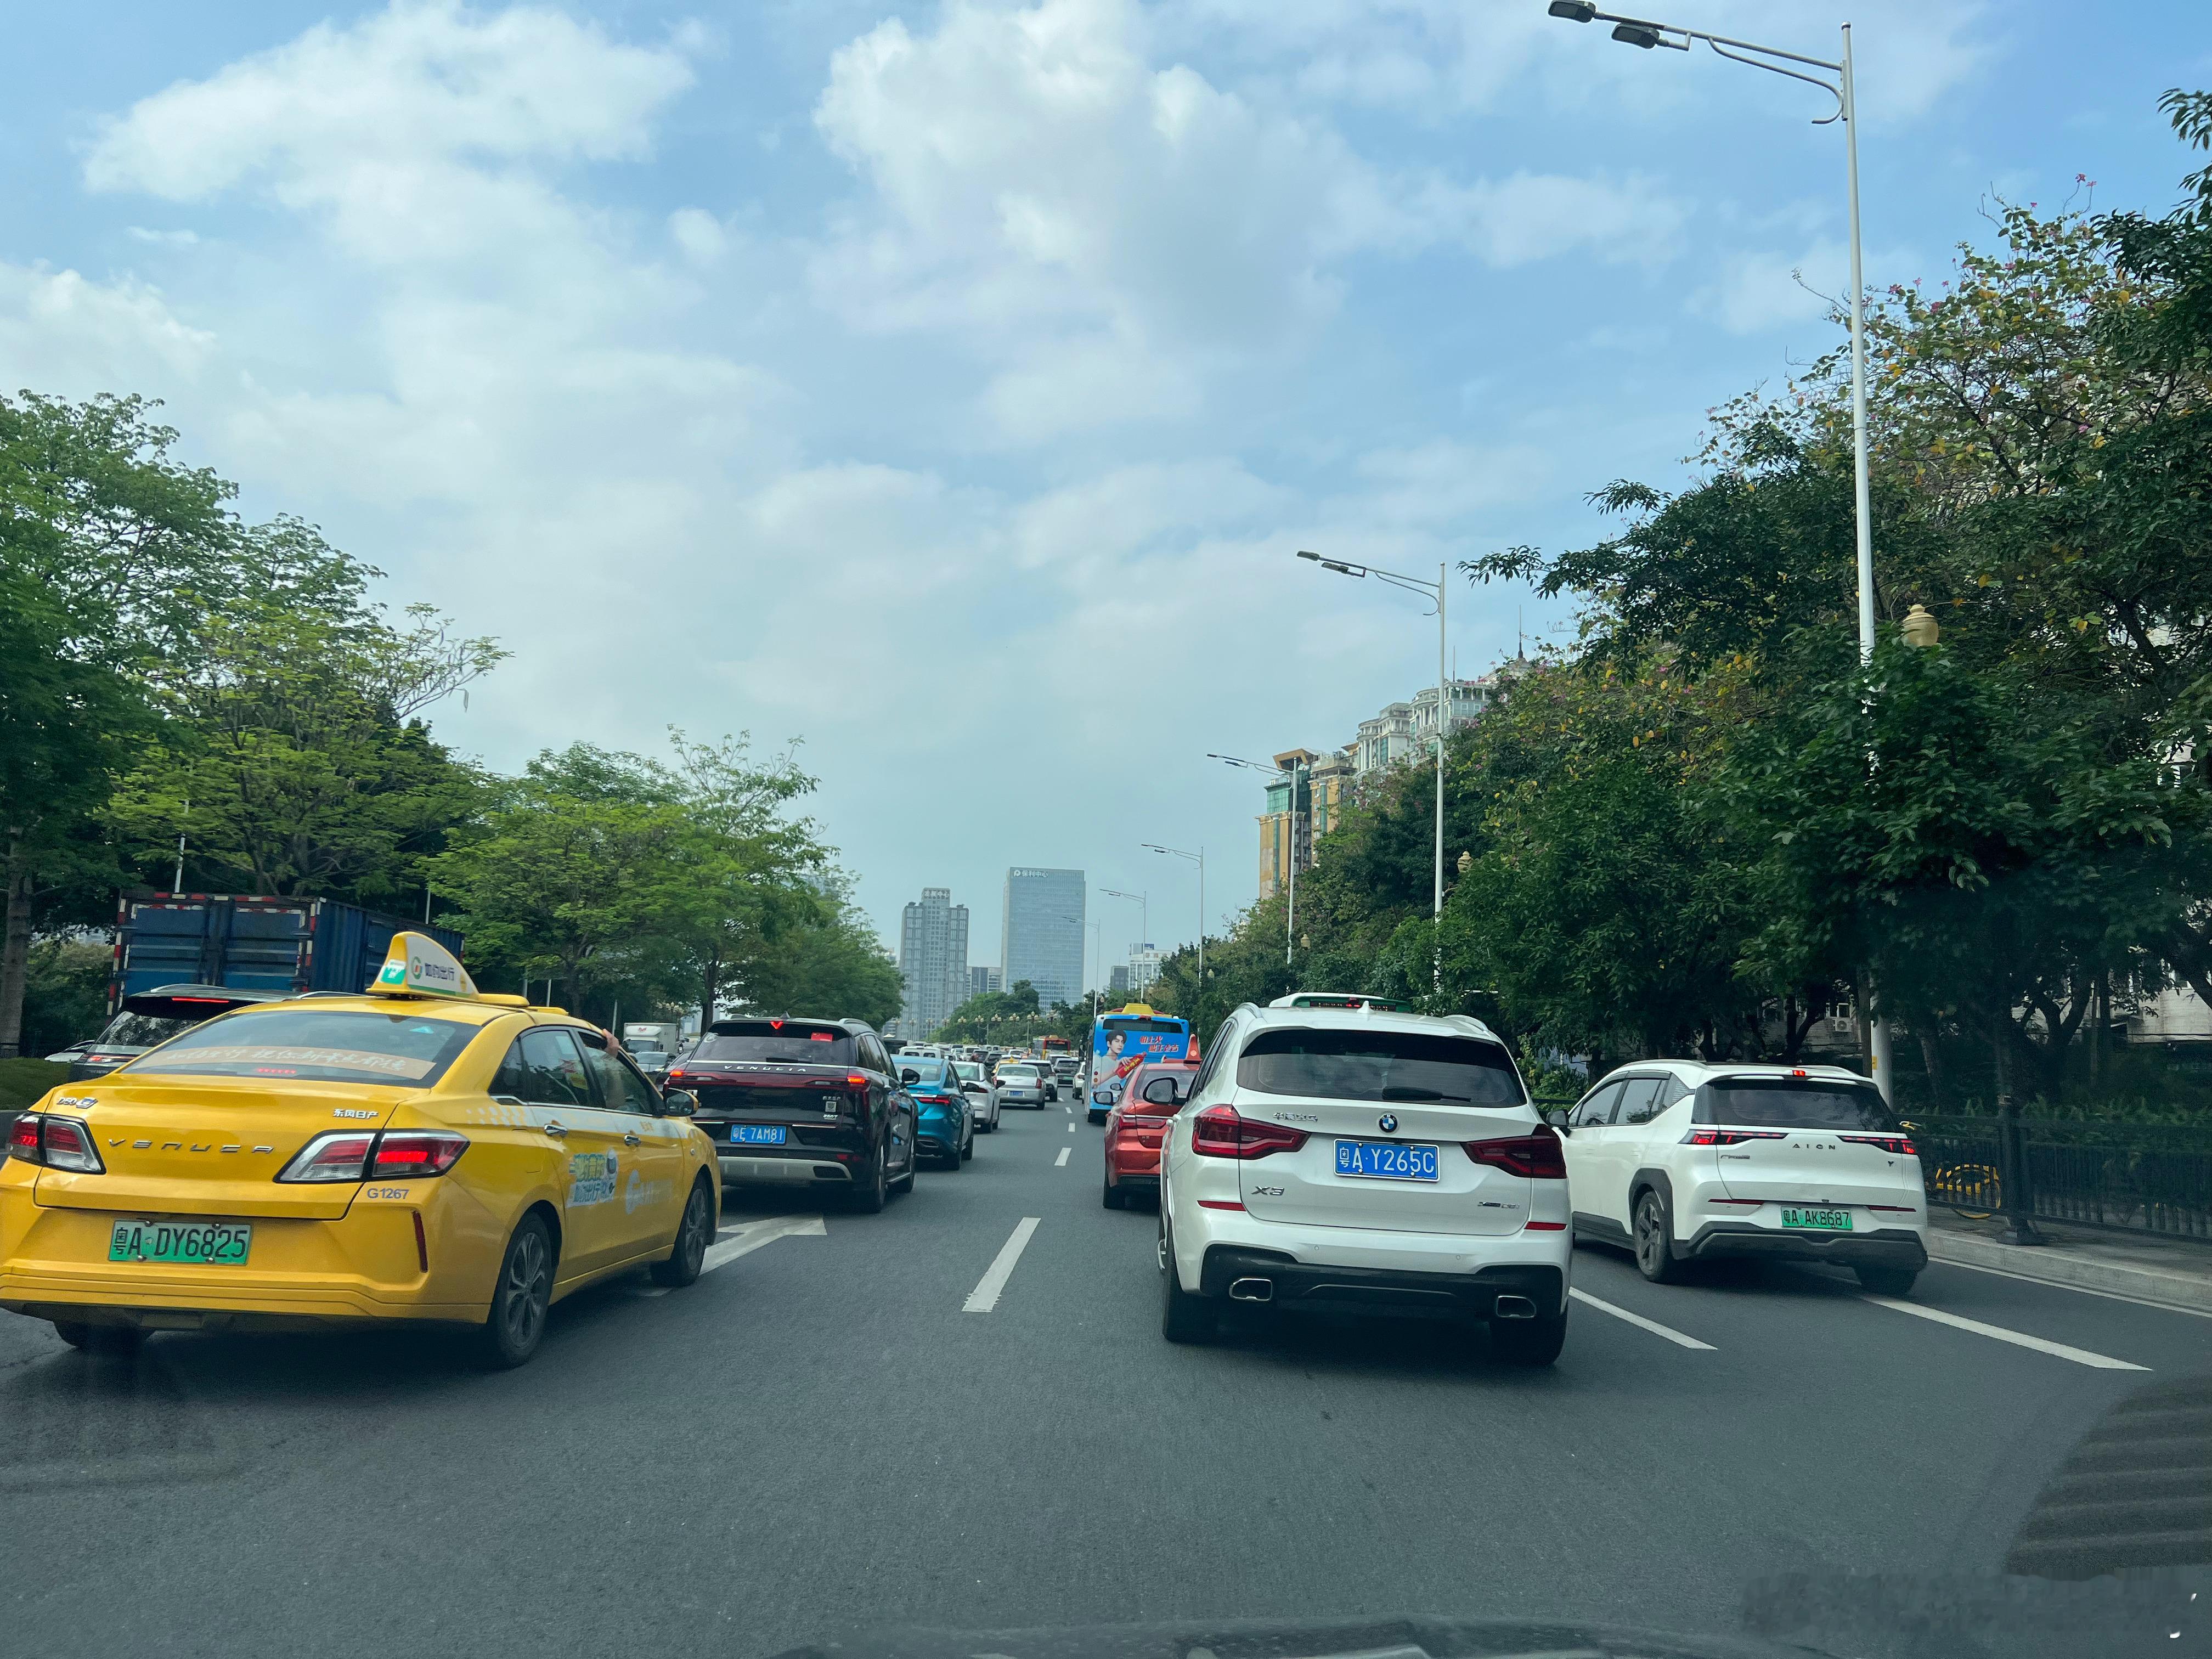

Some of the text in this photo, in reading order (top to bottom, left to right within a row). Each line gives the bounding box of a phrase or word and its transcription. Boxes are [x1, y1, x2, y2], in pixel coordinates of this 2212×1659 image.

[367, 1188, 410, 1200] G1267
[1251, 1186, 1285, 1196] X3
[154, 1227, 249, 1258] DY6825
